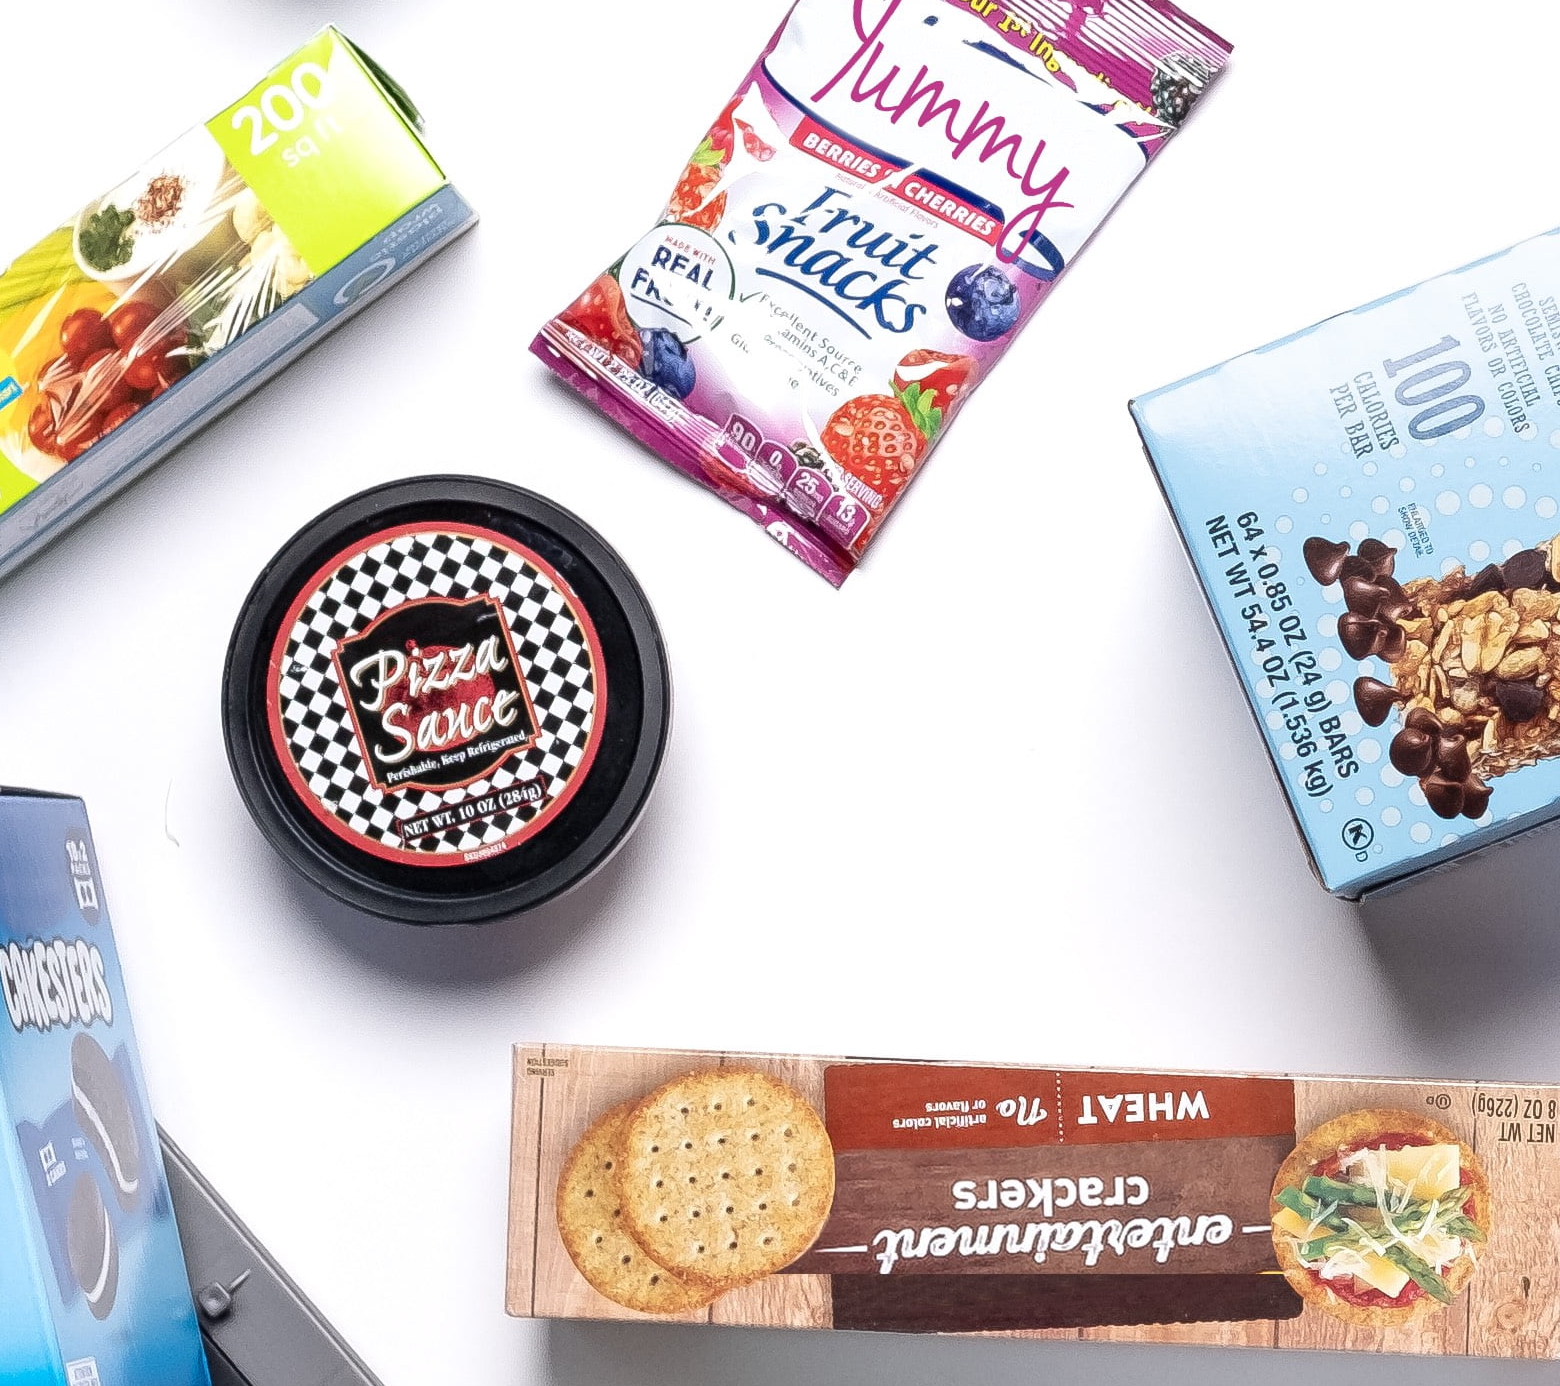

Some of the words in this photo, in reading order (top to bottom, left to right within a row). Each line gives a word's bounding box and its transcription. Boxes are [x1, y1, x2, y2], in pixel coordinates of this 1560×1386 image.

[231, 62, 331, 157] 200
[803, 132, 883, 179] BERRIES
[903, 176, 997, 236] CHERRIES
[793, 185, 939, 281] Fruit
[651, 244, 714, 292] REAL
[728, 201, 928, 334] Snacks
[1461, 291, 1498, 353] FLAVORS
[1488, 303, 1508, 325] NO
[1511, 282, 1554, 361] CHOCOLATE
[1382, 334, 1486, 440] 100
[1497, 328, 1541, 408] ARTIFICIAL
[1329, 382, 1357, 420] PER
[1344, 420, 1374, 460] BAR
[1353, 371, 1400, 451] CALORIES
[1497, 381, 1530, 434] COLORS
[1204, 514, 1241, 559] NET
[1236, 511, 1266, 543] 64
[1224, 561, 1257, 600] WT
[1256, 562, 1293, 612] 0.85
[1240, 602, 1276, 653] 54.4
[1278, 614, 1308, 648] OZ
[350, 633, 509, 710] Pizza
[1262, 654, 1291, 688] OZ
[1288, 648, 1323, 687] (24
[374, 686, 520, 762] Sauce
[1271, 691, 1319, 759] (1.536
[1318, 714, 1360, 780] BARS
[1304, 759, 1335, 798] kg)
[403, 817, 431, 839] NET
[476, 796, 498, 815] OZ
[931, 1115, 988, 1132] artificial
[995, 1095, 1048, 1129] No
[1075, 1090, 1211, 1126] WHEAT
[1470, 1092, 1514, 1119] (226g)
[1516, 1096, 1546, 1120] OZ
[1497, 1119, 1525, 1142] WT
[1525, 1120, 1557, 1144] NET
[951, 1176, 1151, 1213] crackers
[871, 1212, 1234, 1273] entertainment
